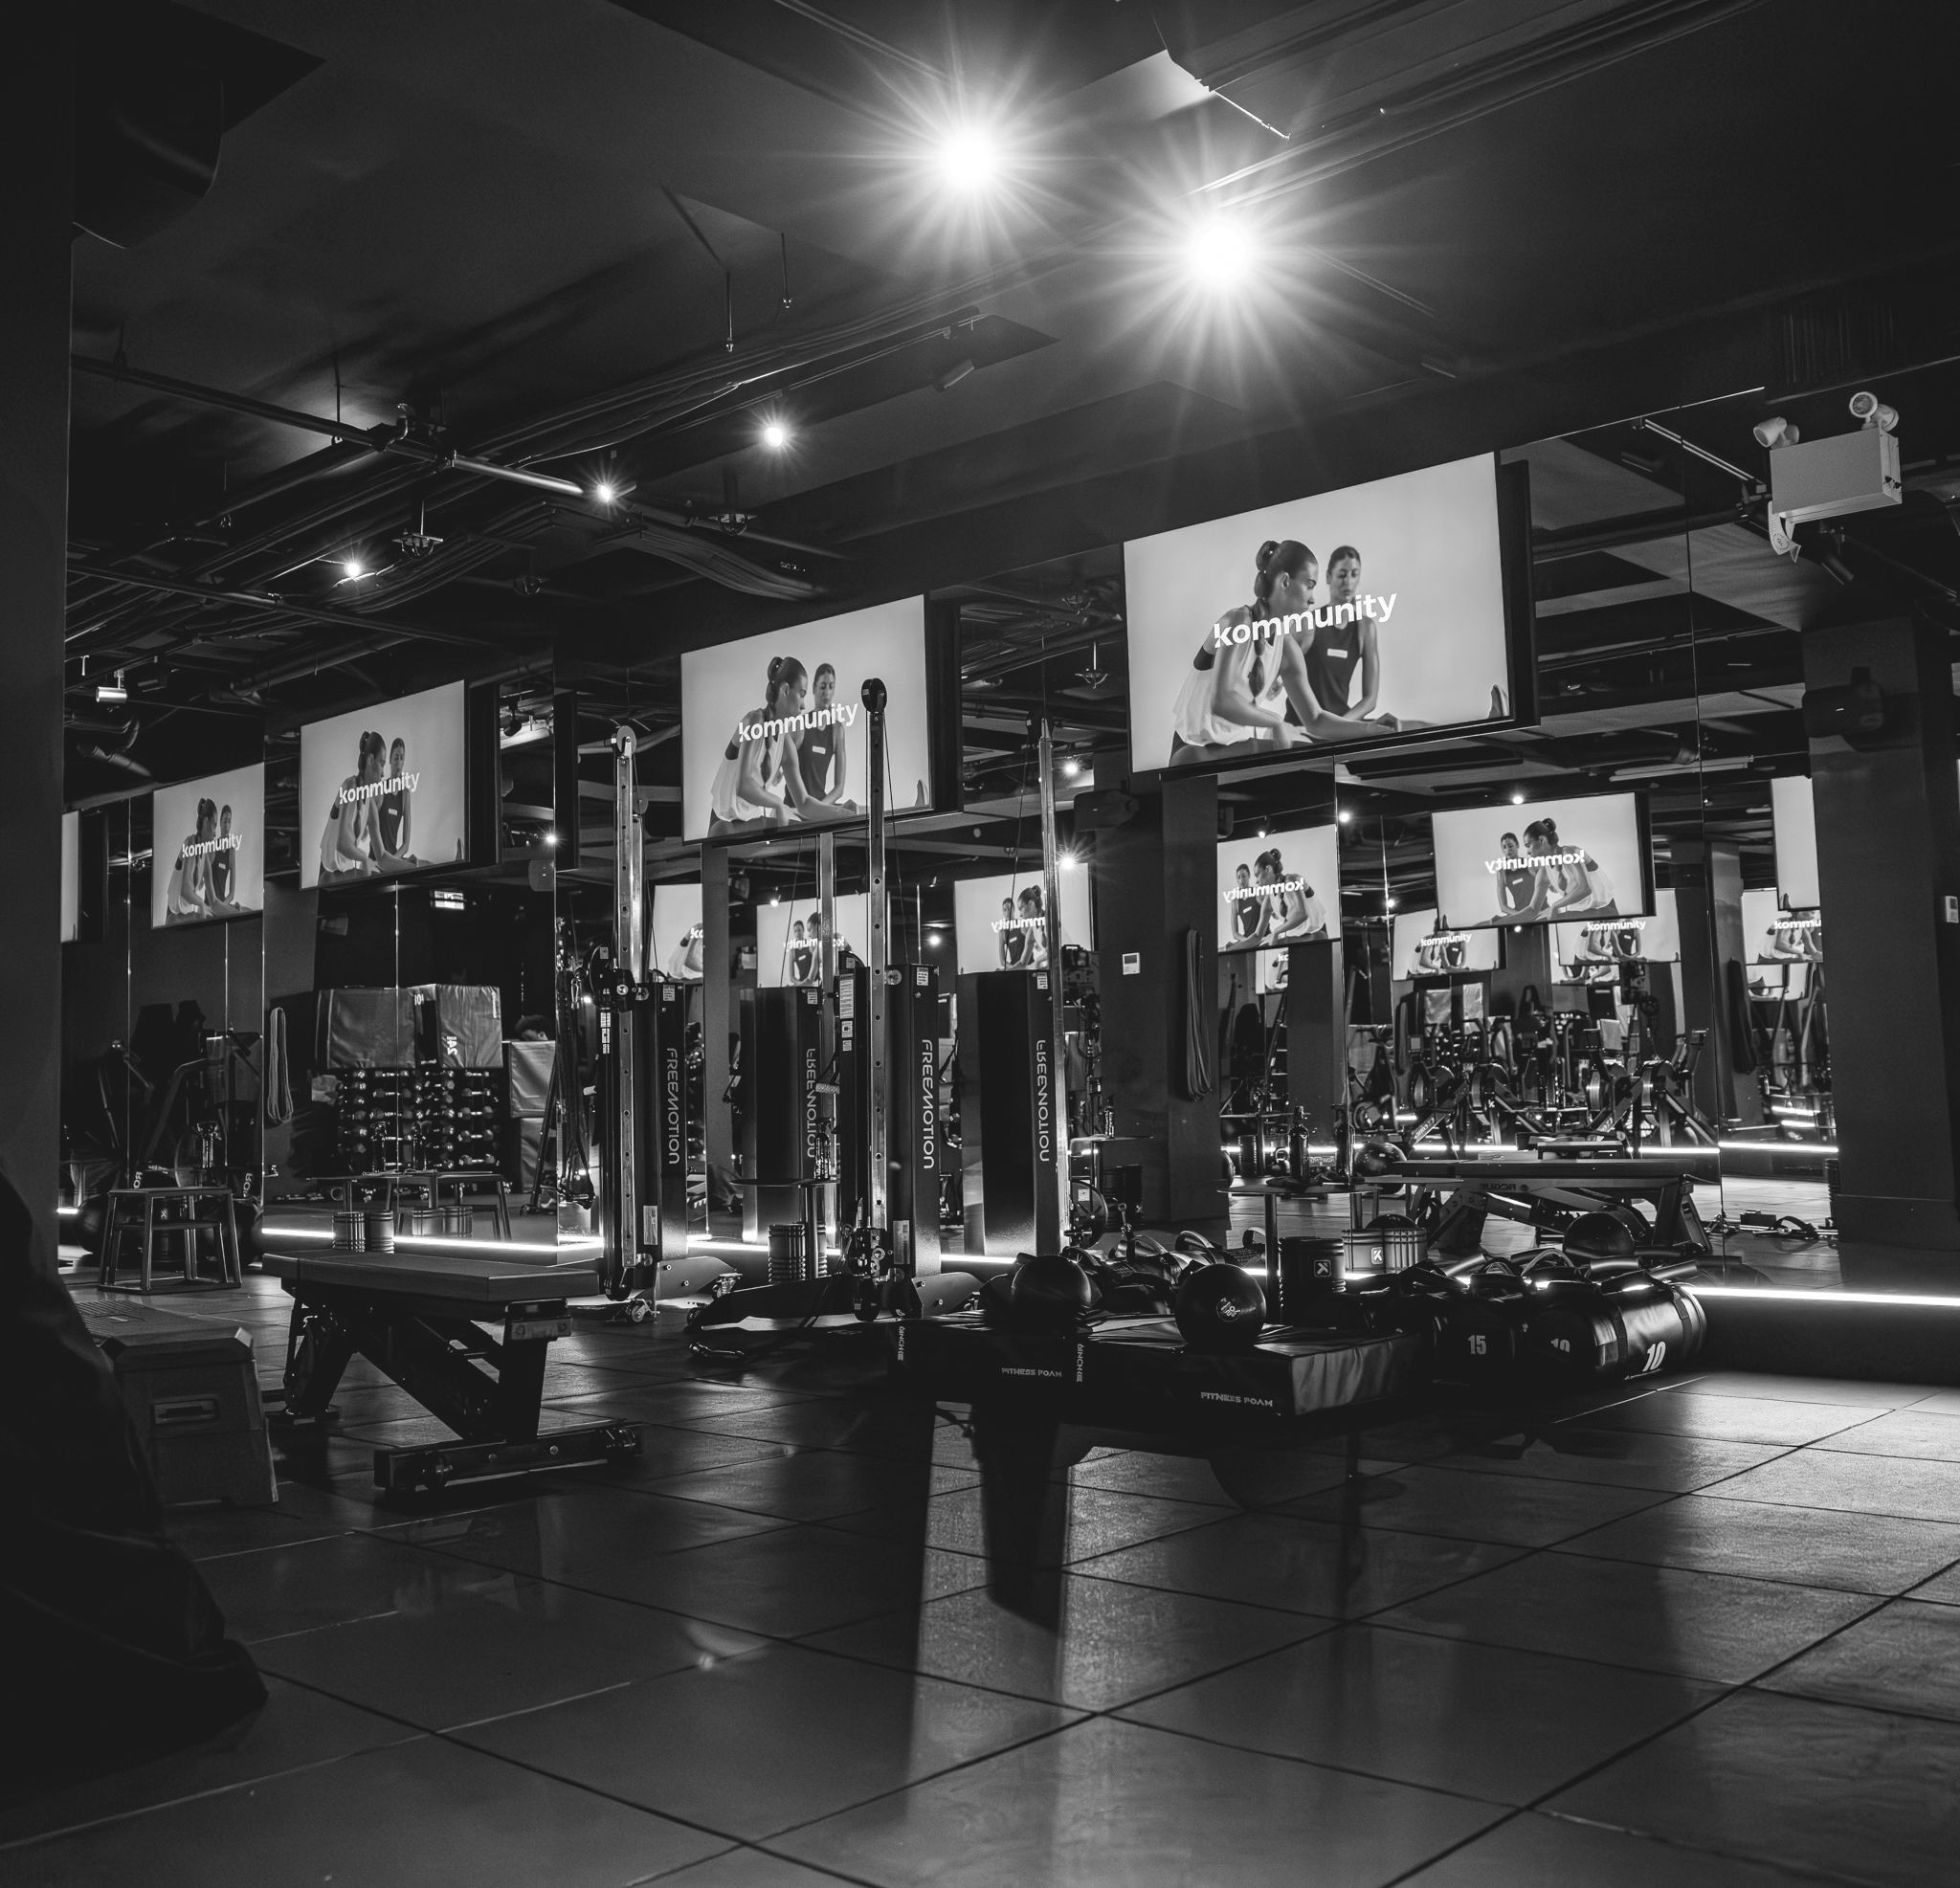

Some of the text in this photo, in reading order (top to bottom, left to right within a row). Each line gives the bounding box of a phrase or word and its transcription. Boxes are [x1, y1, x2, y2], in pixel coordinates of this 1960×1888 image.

[1214, 593, 1397, 649] kommunity
[739, 703, 858, 743] kommunity
[340, 772, 420, 804] kommunity
[182, 833, 242, 857] kommunity
[1587, 920, 1646, 932] kommunity
[1774, 920, 1821, 930] kommu
[1421, 932, 1472, 947] kommunity
[667, 1048, 680, 1165] FREEMOTION
[922, 1039, 935, 1168] FREEMOTION
[1468, 1335, 1487, 1355] 15
[1642, 1342, 1666, 1372] 10
[1001, 1367, 1036, 1377] FITNESS
[1199, 1391, 1273, 1408] FITNESS FOAM
